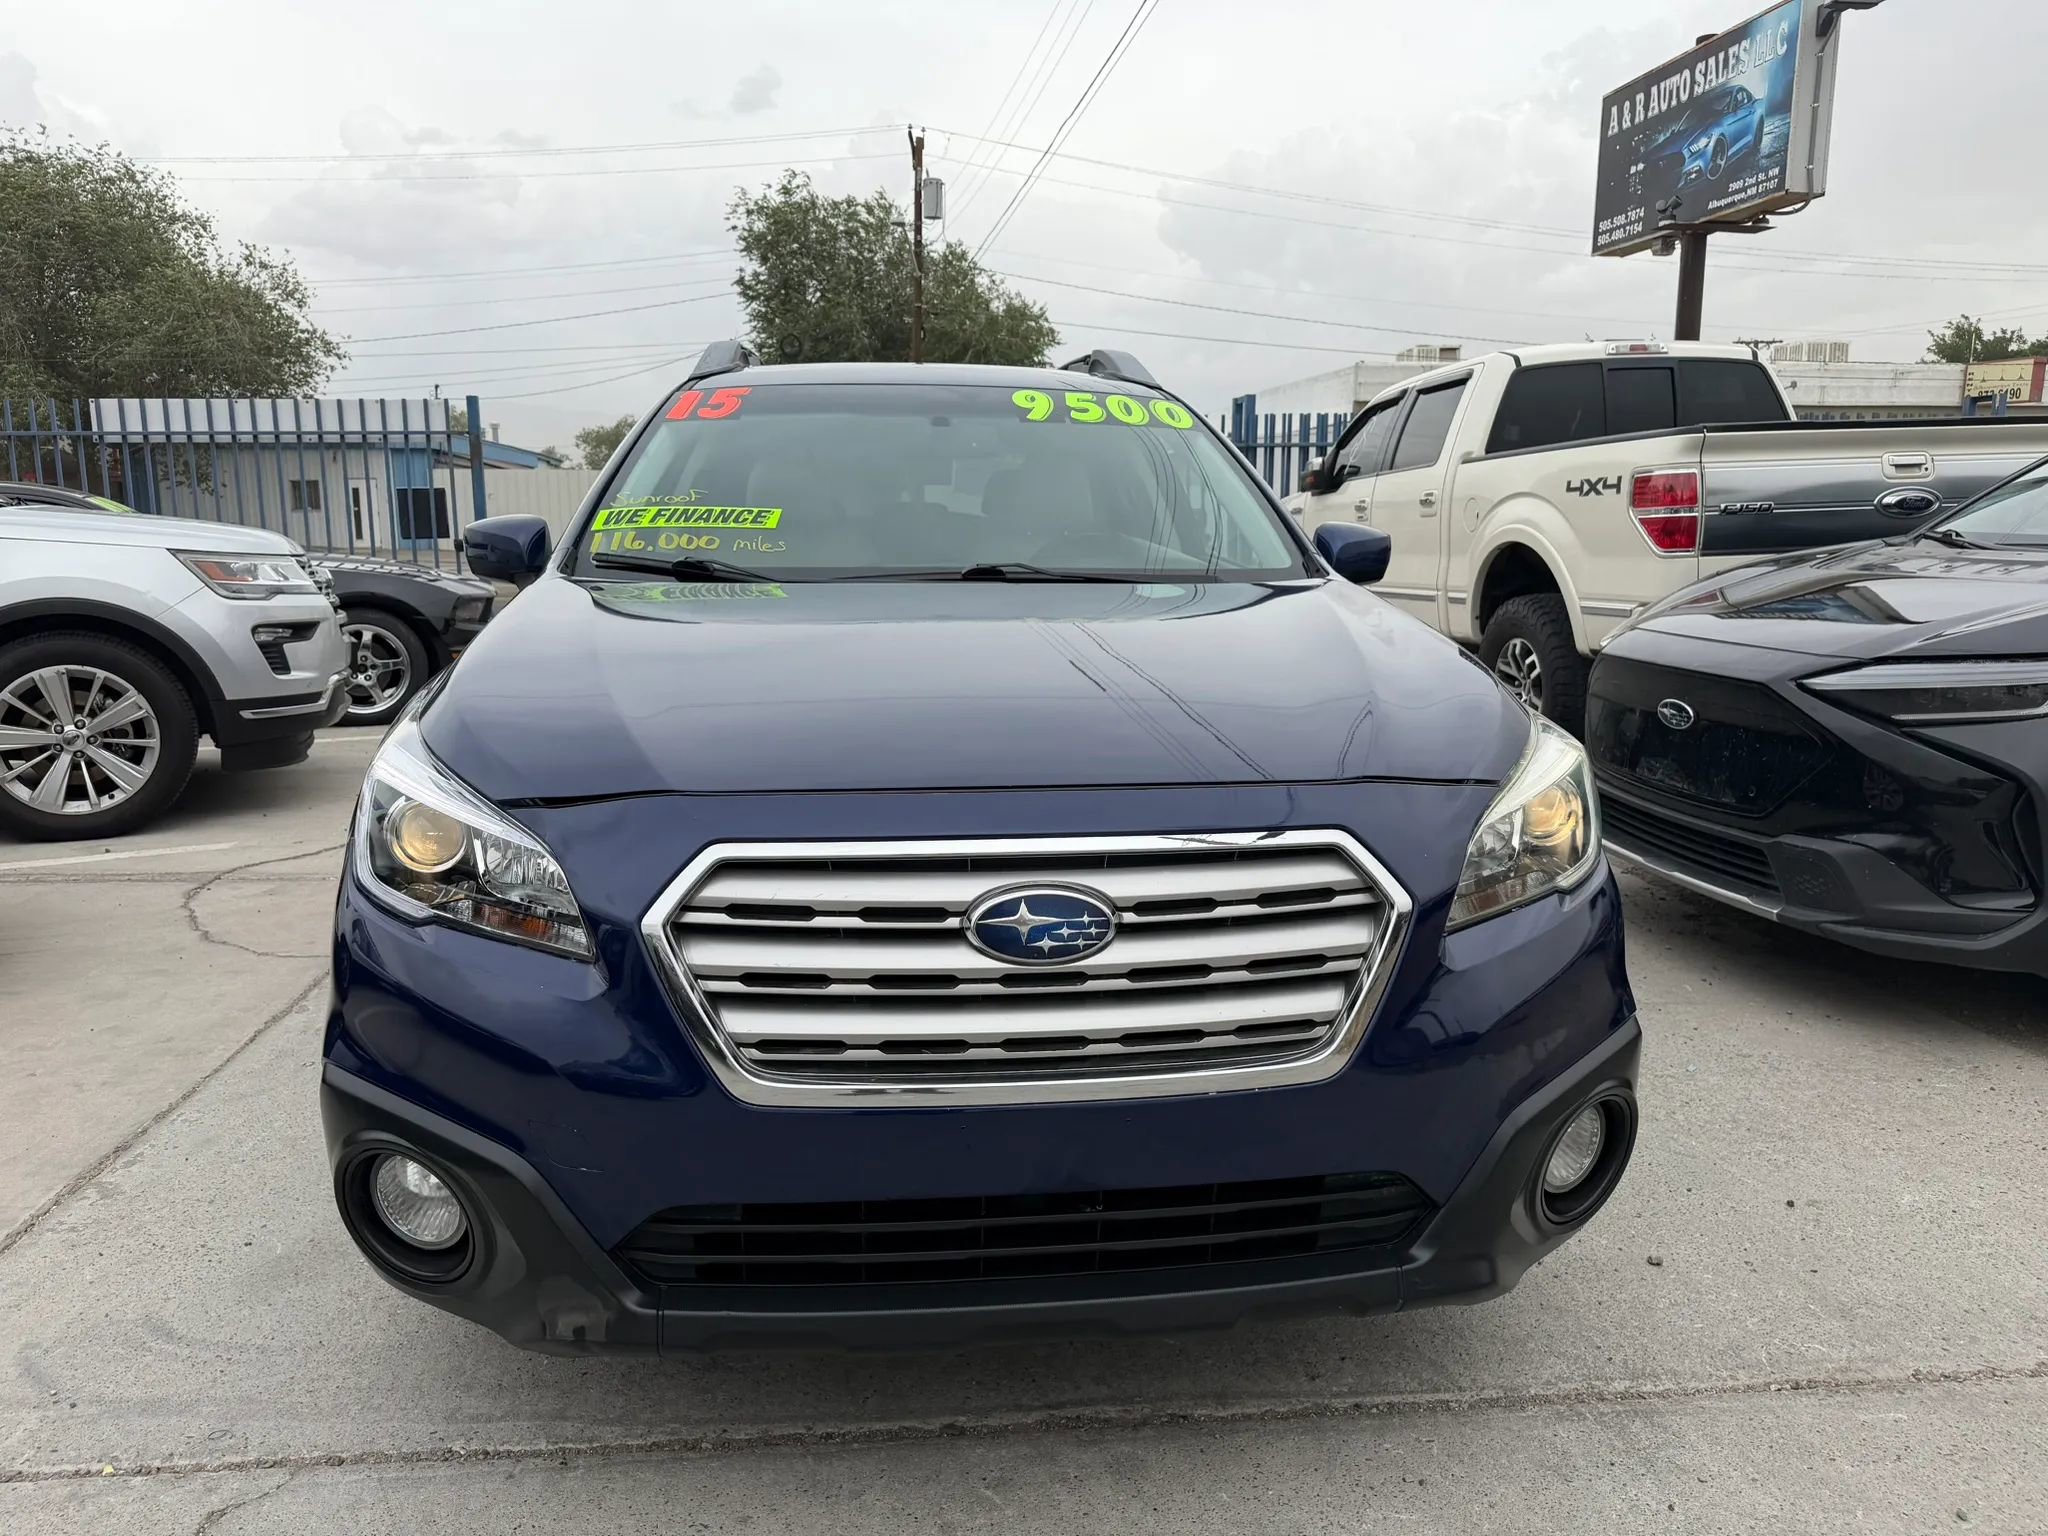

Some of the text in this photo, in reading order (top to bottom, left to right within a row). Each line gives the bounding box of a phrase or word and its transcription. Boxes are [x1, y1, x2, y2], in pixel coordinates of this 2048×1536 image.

[1607, 104, 1619, 137] A
[1621, 100, 1632, 131] &
[1634, 92, 1646, 125] R
[1647, 68, 1691, 119] AUTO
[1693, 37, 1750, 97] SALES
[1744, 174, 1757, 187] 2nd
[1768, 166, 1780, 179] NW
[1758, 179, 1779, 192] 87107
[664, 387, 752, 421] 15
[1012, 389, 1194, 429] 9500
[602, 507, 774, 527] WE FINANCE
[732, 535, 787, 553] miles
